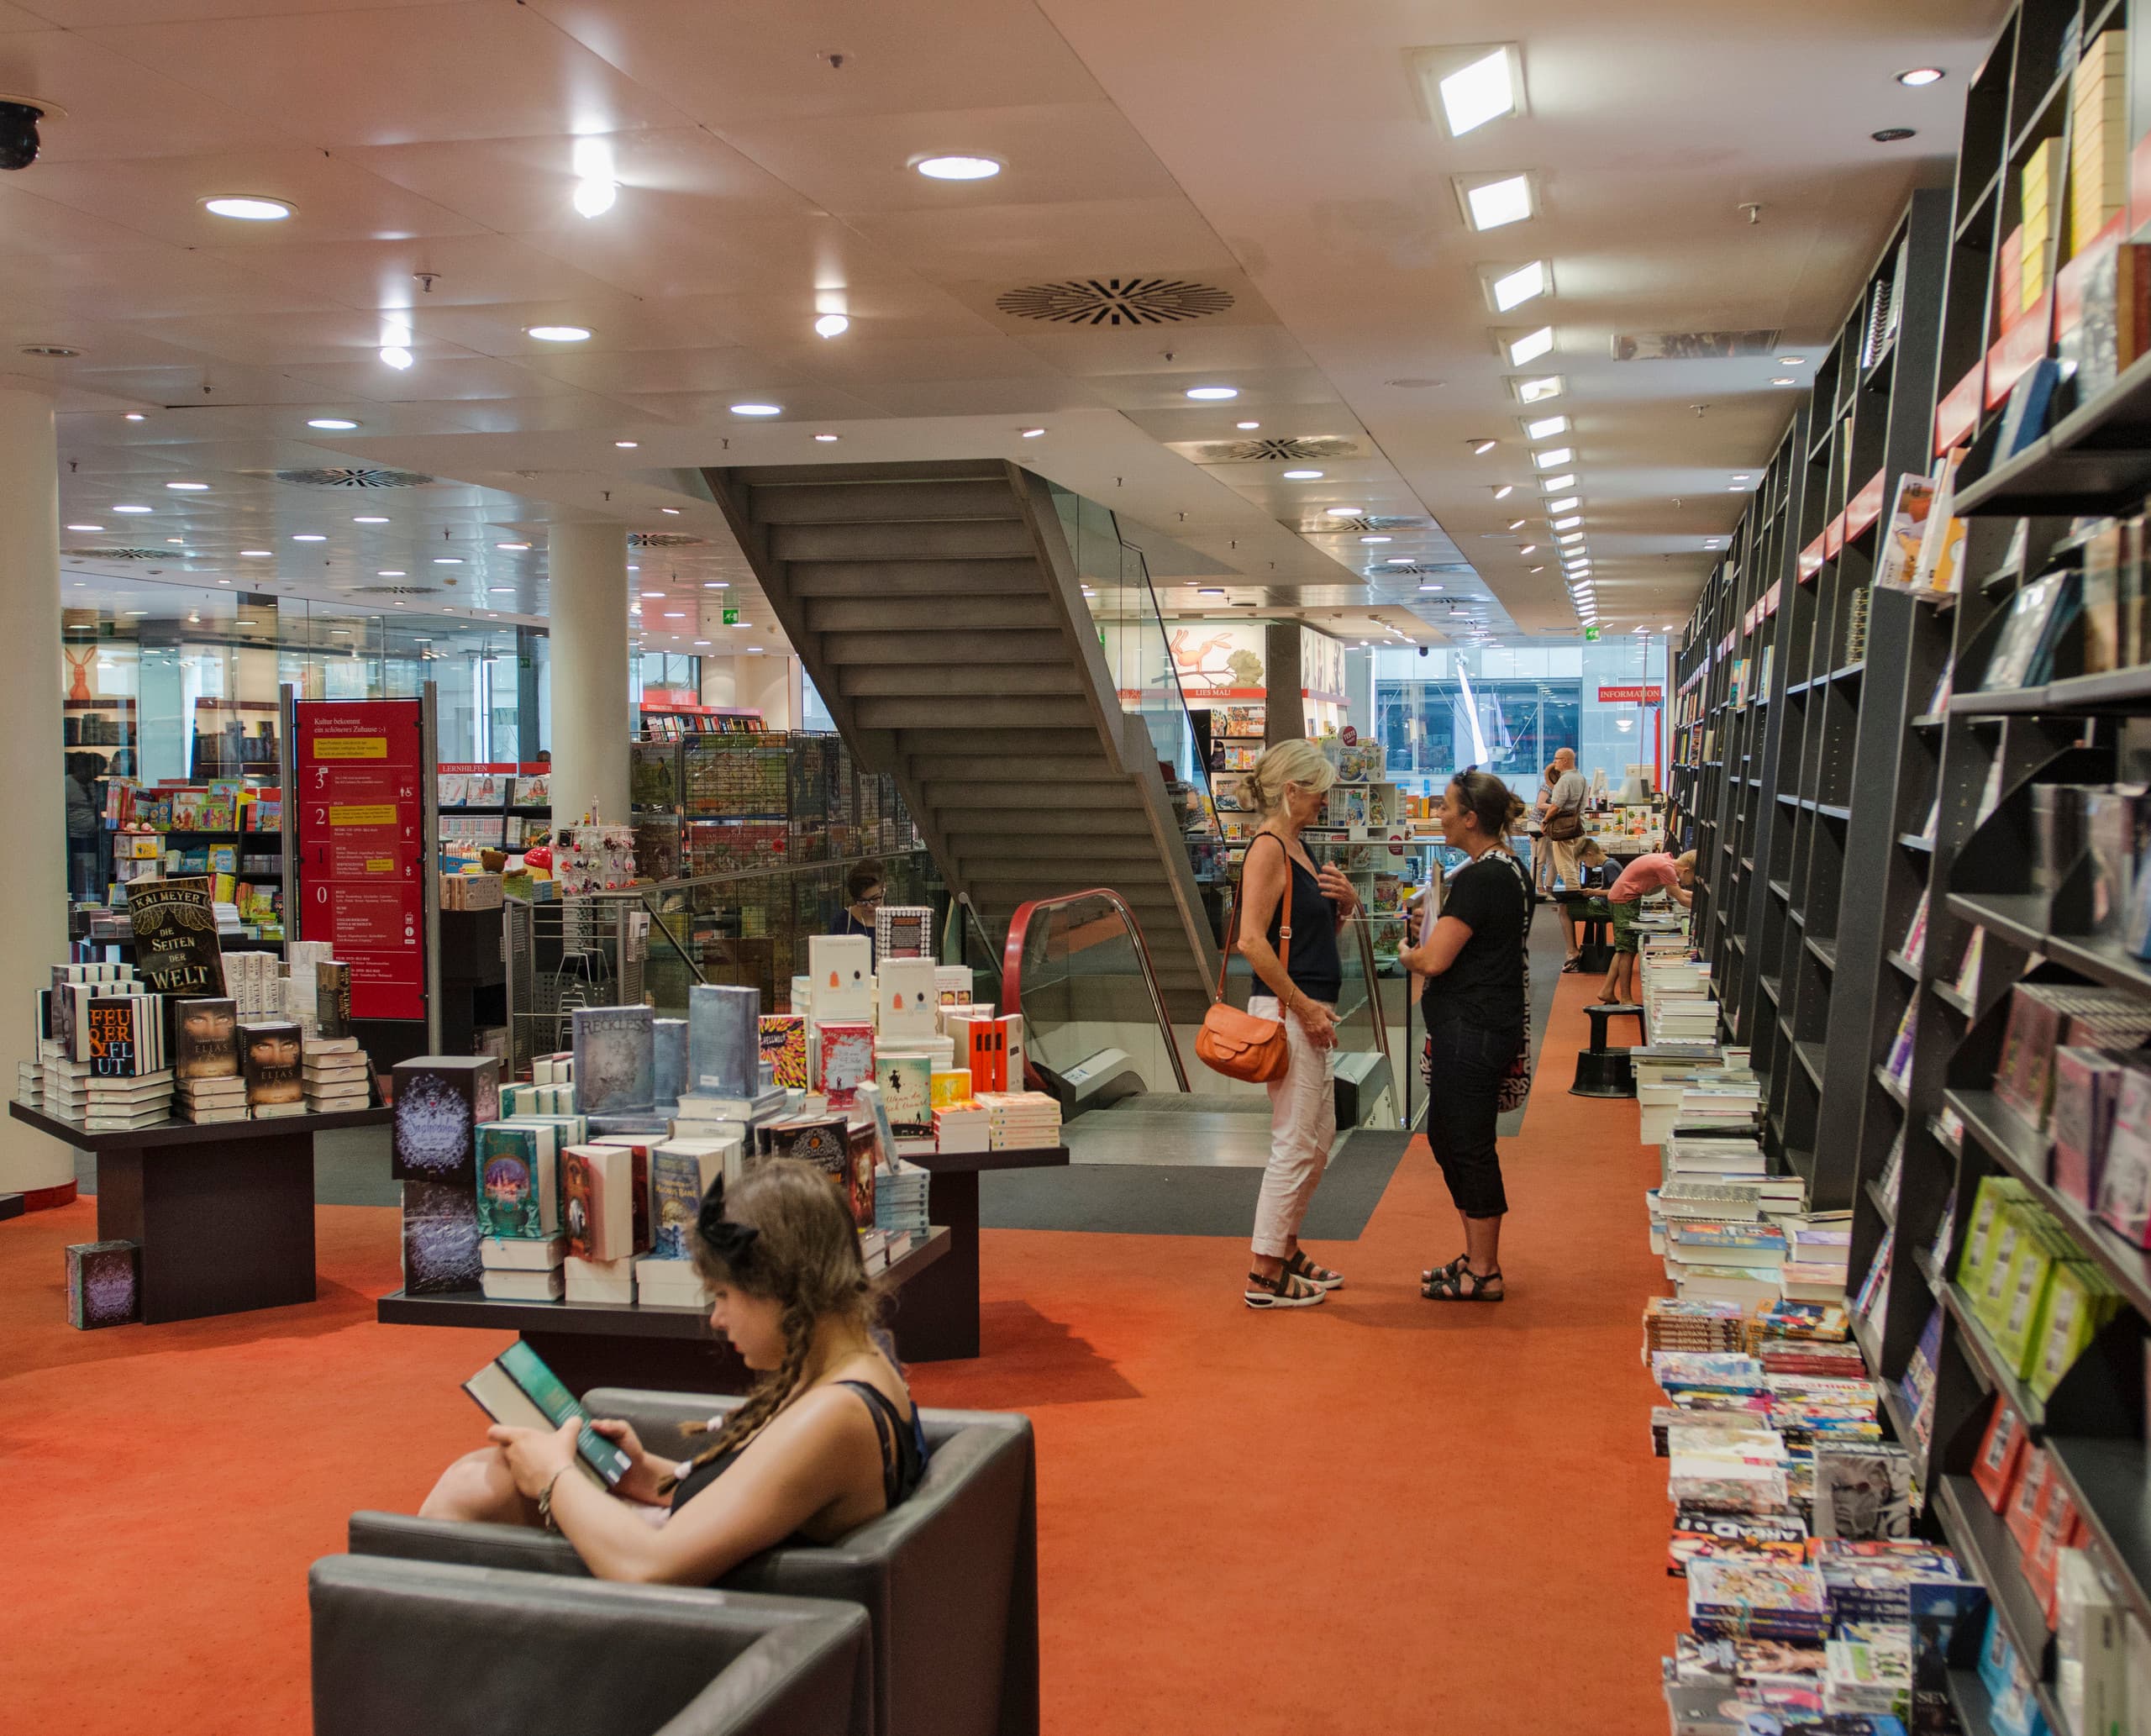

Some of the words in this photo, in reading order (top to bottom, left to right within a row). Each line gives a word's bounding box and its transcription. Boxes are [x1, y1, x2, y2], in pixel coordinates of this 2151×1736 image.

[315, 773, 324, 789] 3
[315, 808, 325, 824] 2
[136, 893, 158, 908] KAI
[160, 890, 200, 903] MEYER
[317, 886, 327, 903] 0
[160, 927, 174, 937] DIE
[152, 937, 195, 952] SEITEN
[169, 953, 187, 962] DER
[151, 966, 208, 989] WELT
[89, 1008, 132, 1026] FEU
[103, 1026, 133, 1042] ER
[580, 1018, 652, 1036] RECKLESS
[89, 1028, 108, 1057] &
[109, 1042, 134, 1058] FL
[195, 1044, 229, 1053] ELIAS
[97, 1059, 126, 1075] UT
[261, 1070, 294, 1080] ELIAS
